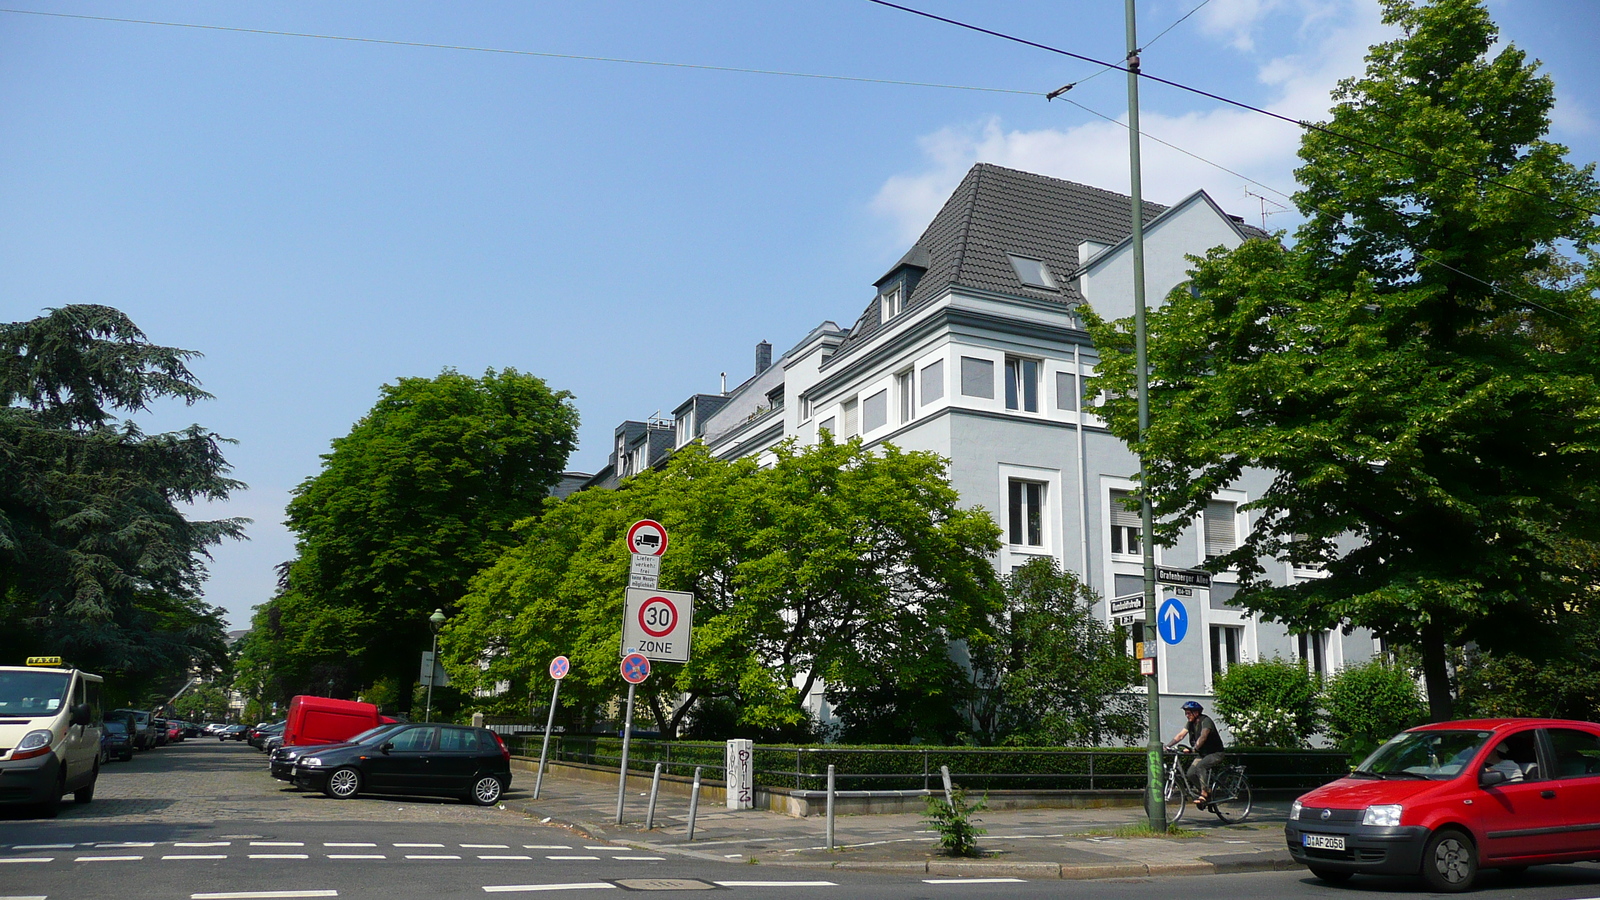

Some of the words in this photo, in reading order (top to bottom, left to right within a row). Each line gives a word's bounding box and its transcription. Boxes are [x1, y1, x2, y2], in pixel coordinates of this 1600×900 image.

[1159, 570, 1194, 584] Grafenberger
[646, 606, 669, 627] 30
[638, 640, 673, 654] ZONE
[1325, 838, 1344, 849] 2058
